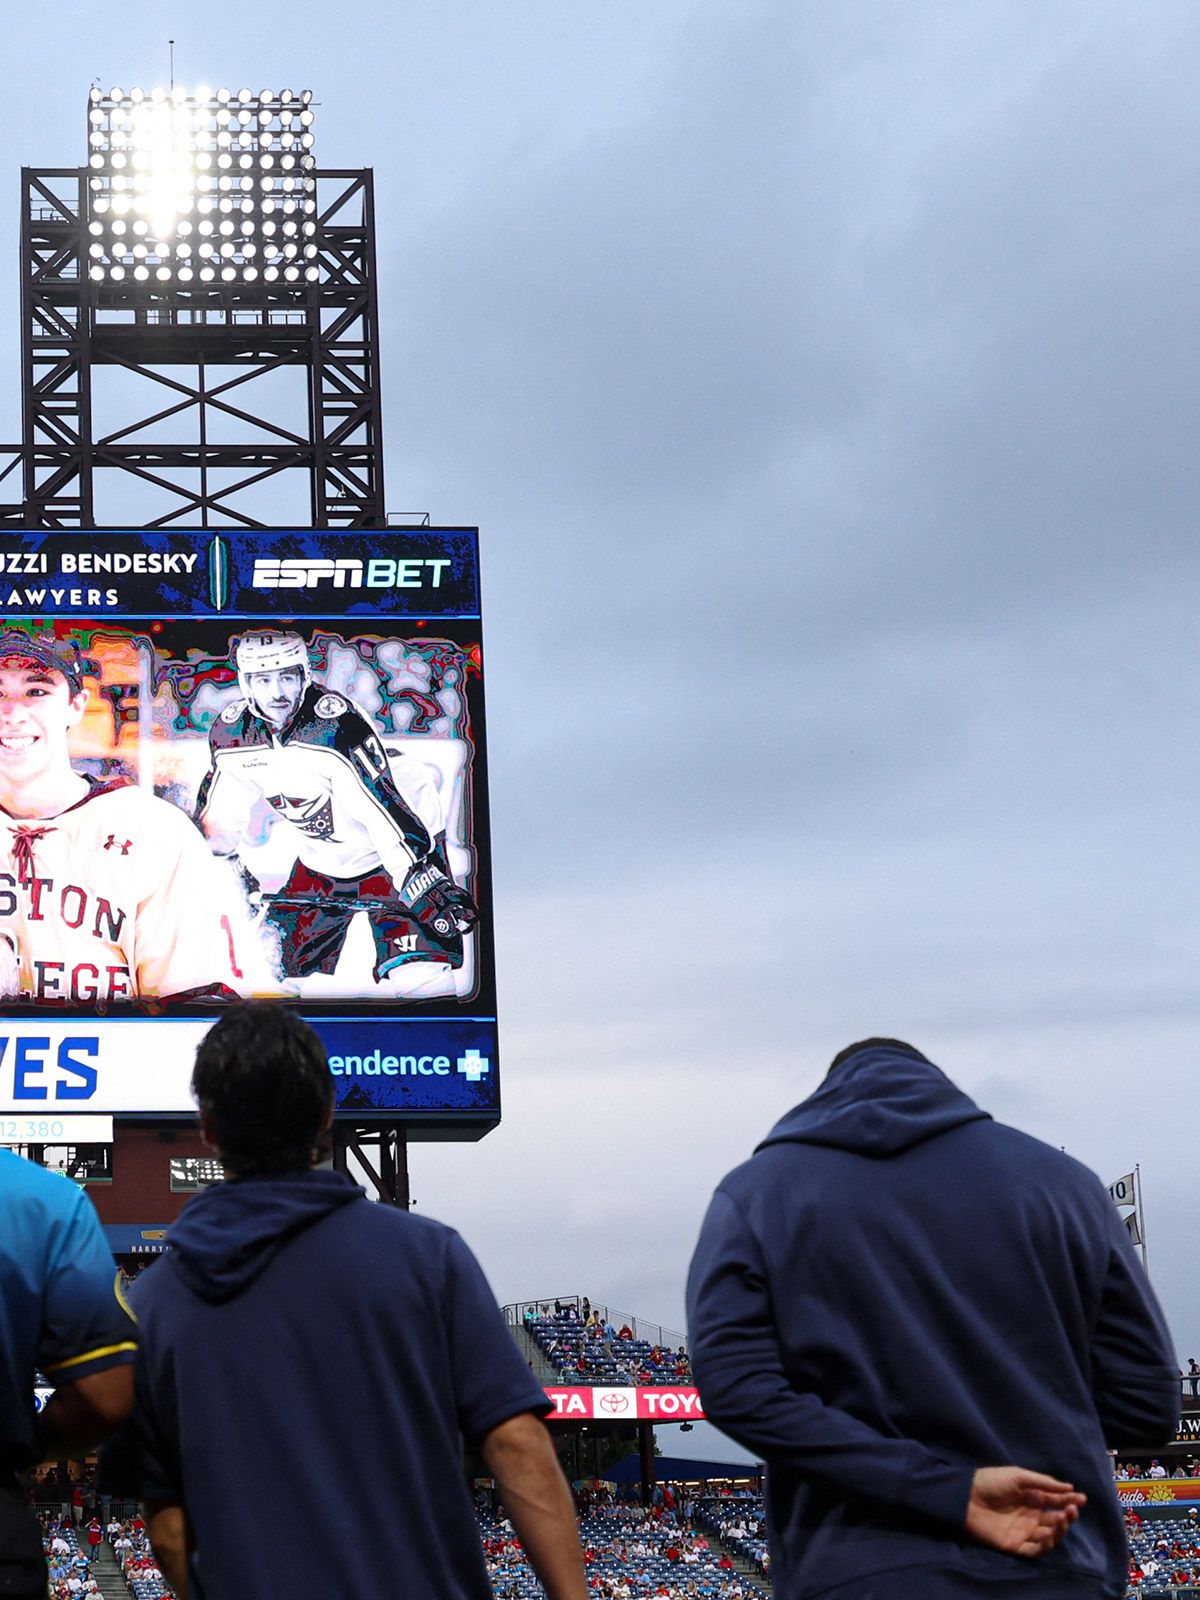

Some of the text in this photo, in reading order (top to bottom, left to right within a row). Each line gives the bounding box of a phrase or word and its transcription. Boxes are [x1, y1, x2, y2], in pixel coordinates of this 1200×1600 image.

[61, 553, 198, 574] BENDESKY
[253, 559, 451, 588] ESPN BET
[19, 960, 131, 1001] EGE
[550, 1393, 587, 1413] TA
